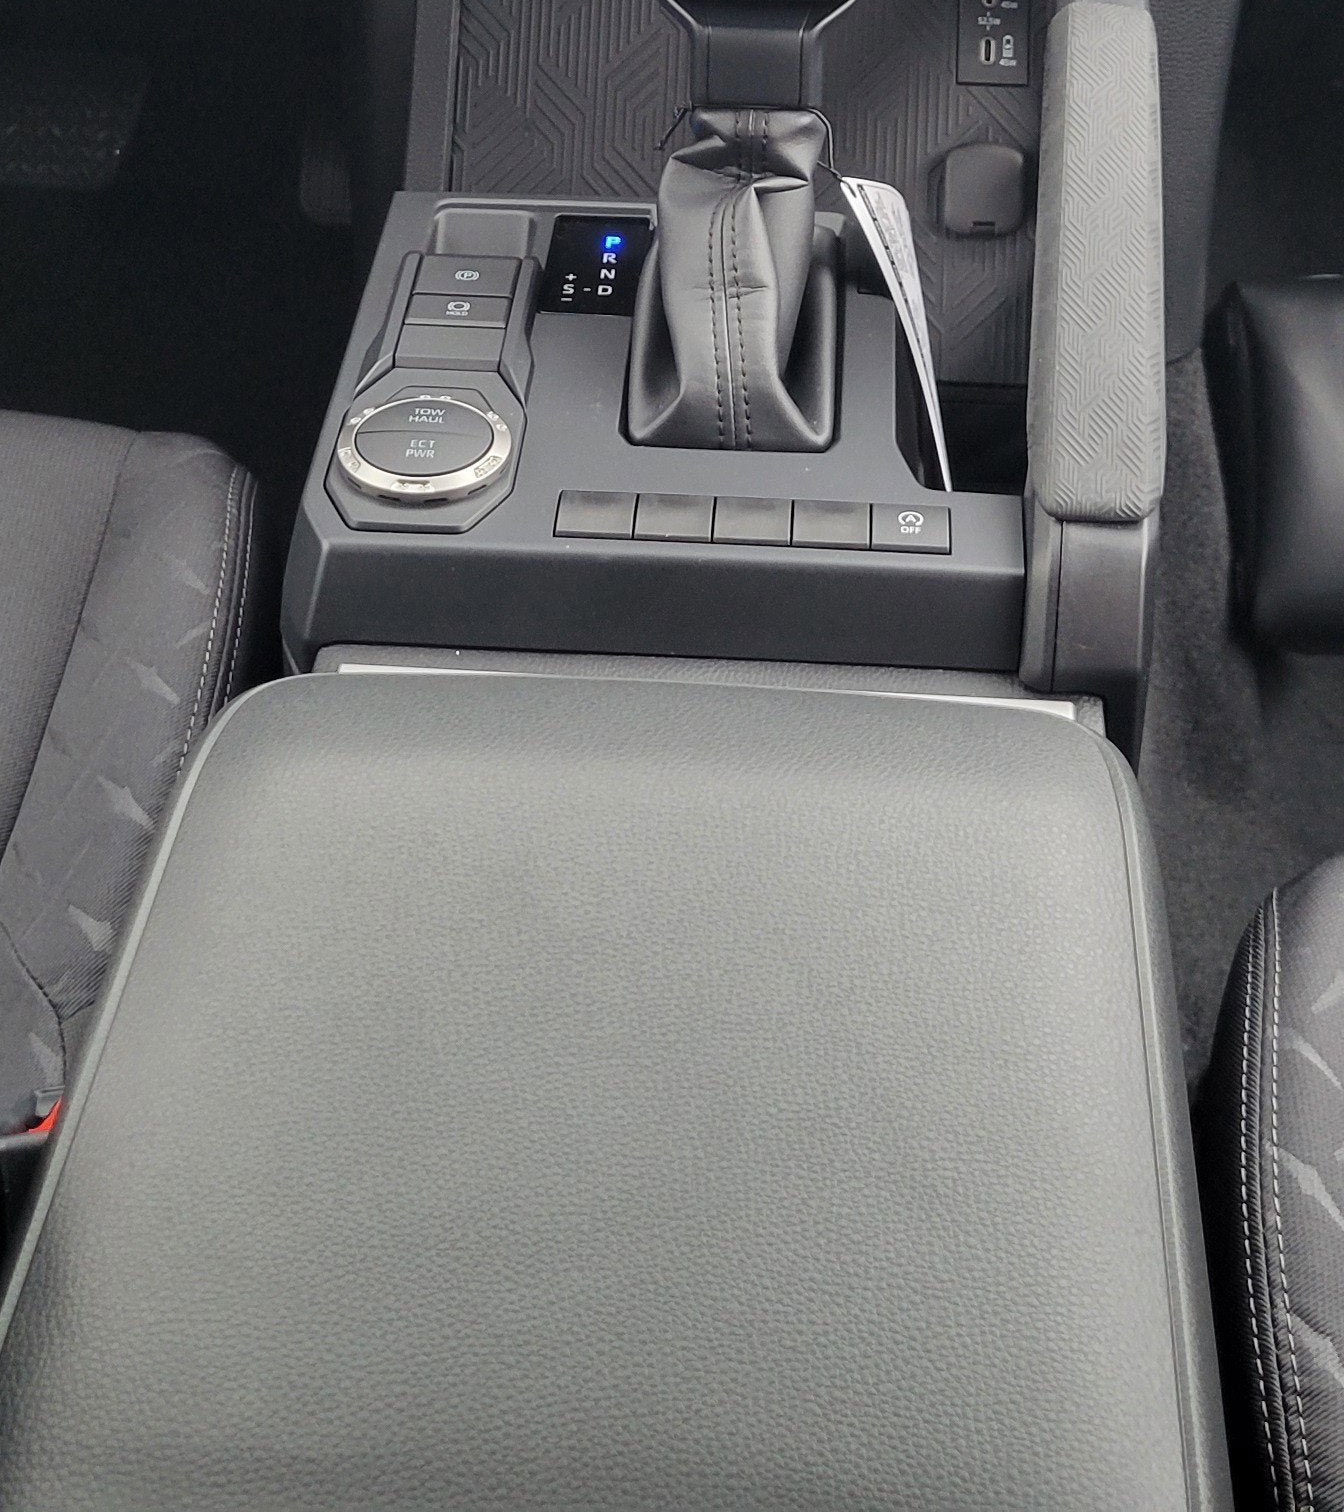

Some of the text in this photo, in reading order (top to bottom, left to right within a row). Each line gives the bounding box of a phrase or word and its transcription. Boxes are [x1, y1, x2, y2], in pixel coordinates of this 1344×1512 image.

[606, 236, 621, 249] P
[602, 252, 617, 264] R
[600, 269, 615, 280] N
[562, 284, 574, 295] S
[597, 285, 613, 296] D
[414, 407, 446, 416] TOW
[408, 415, 445, 424] HAUL
[410, 439, 436, 448] ECT
[406, 449, 435, 458] PWR
[900, 526, 922, 534] OFF
